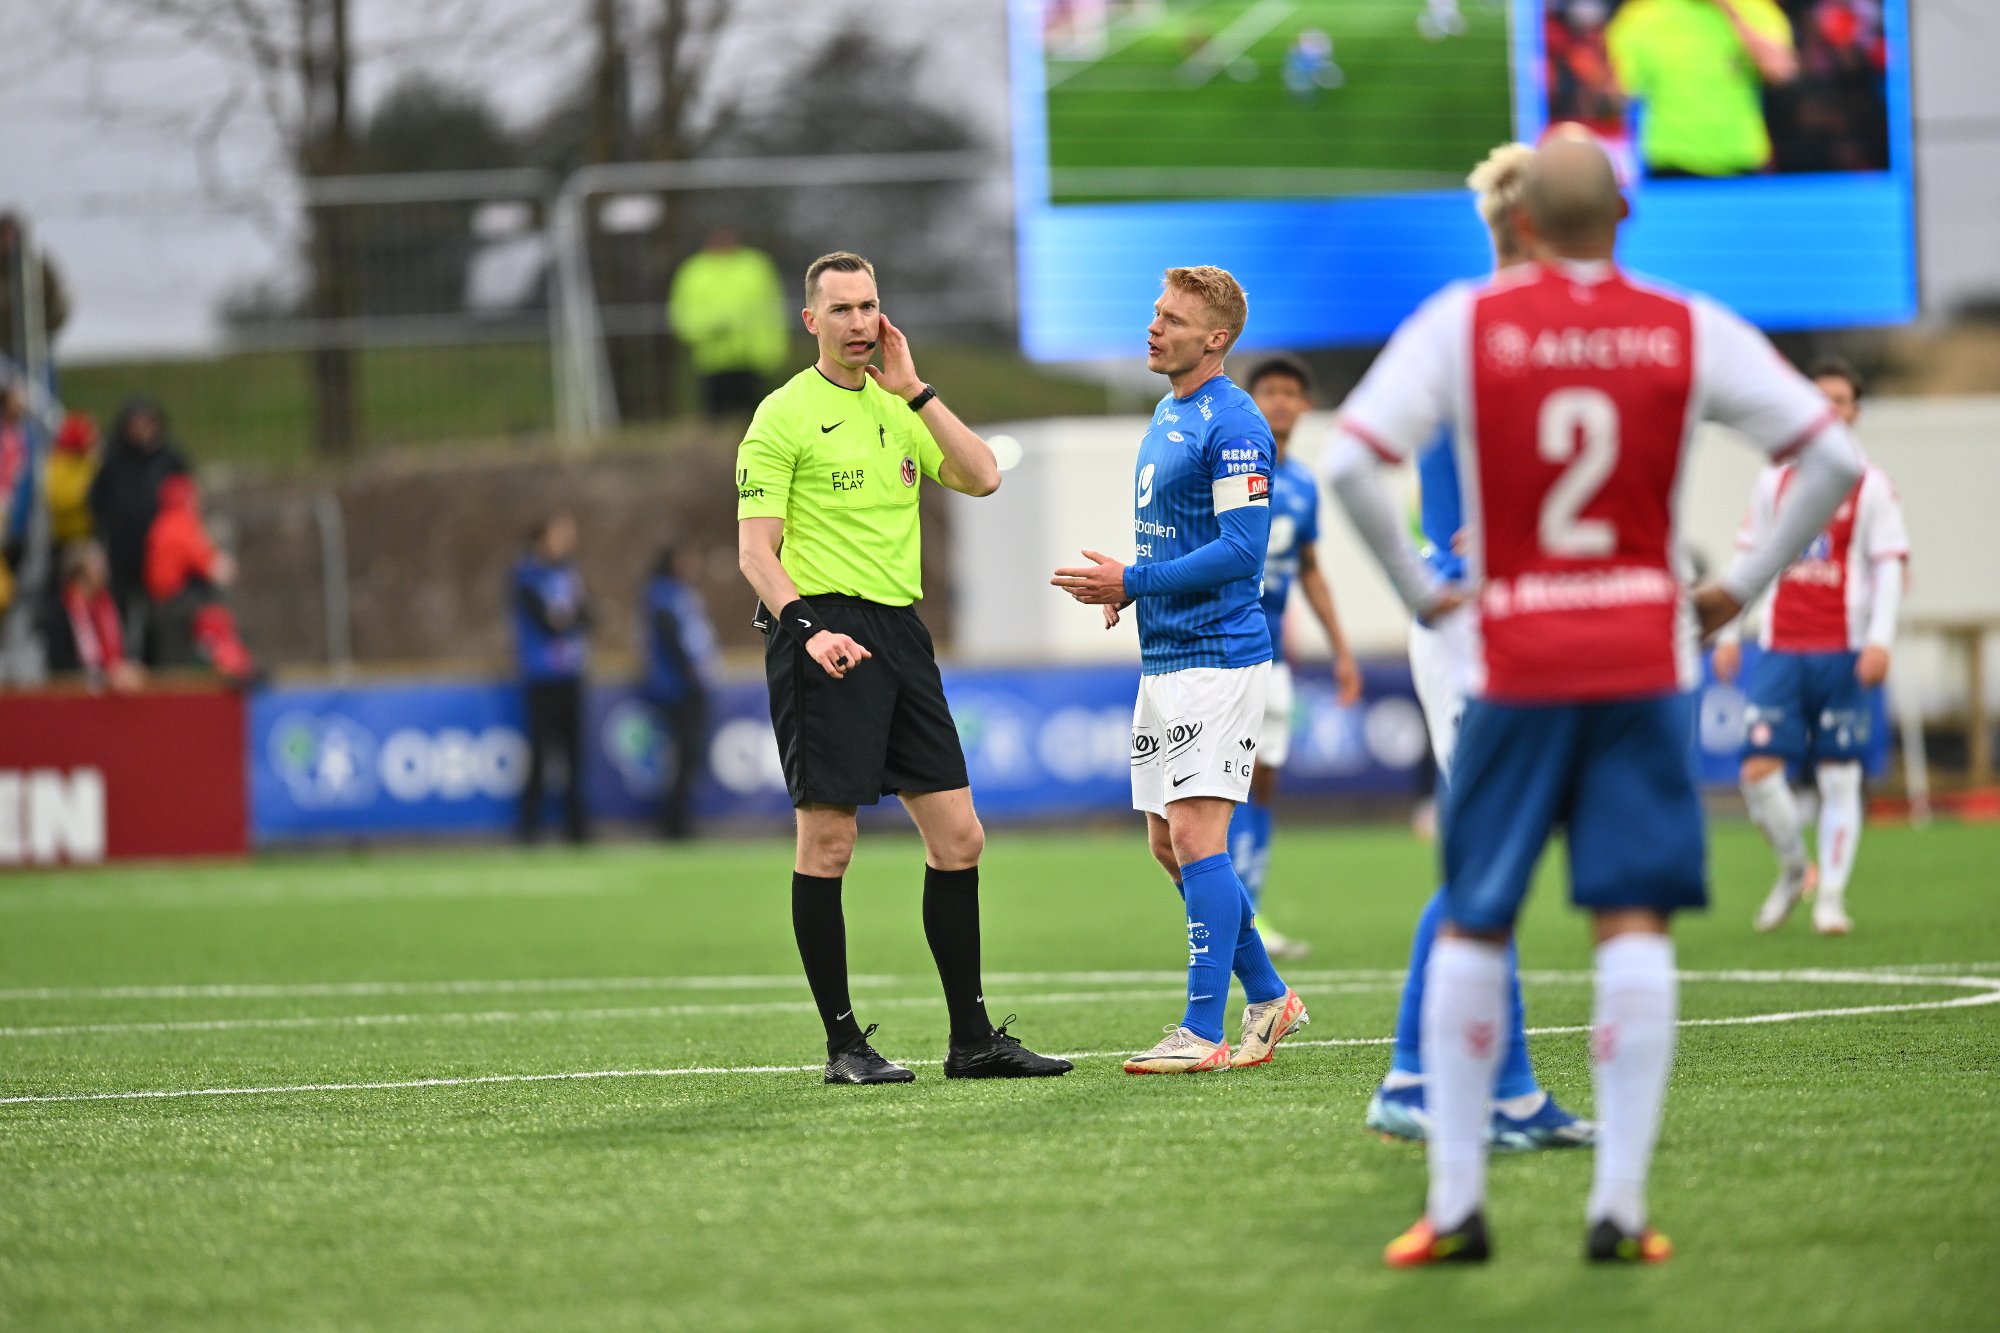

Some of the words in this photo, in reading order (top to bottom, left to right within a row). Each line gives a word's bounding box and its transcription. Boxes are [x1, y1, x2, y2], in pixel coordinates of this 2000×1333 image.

[1531, 326, 1680, 369] ARCTIC
[1222, 449, 1259, 461] REMA
[1227, 462, 1257, 474] 1000
[1537, 386, 1621, 559] 2
[832, 470, 865, 481] FAIR
[833, 480, 865, 491] PLAY
[380, 726, 530, 802] OBO
[1223, 760, 1232, 773] E
[1241, 764, 1250, 777] G
